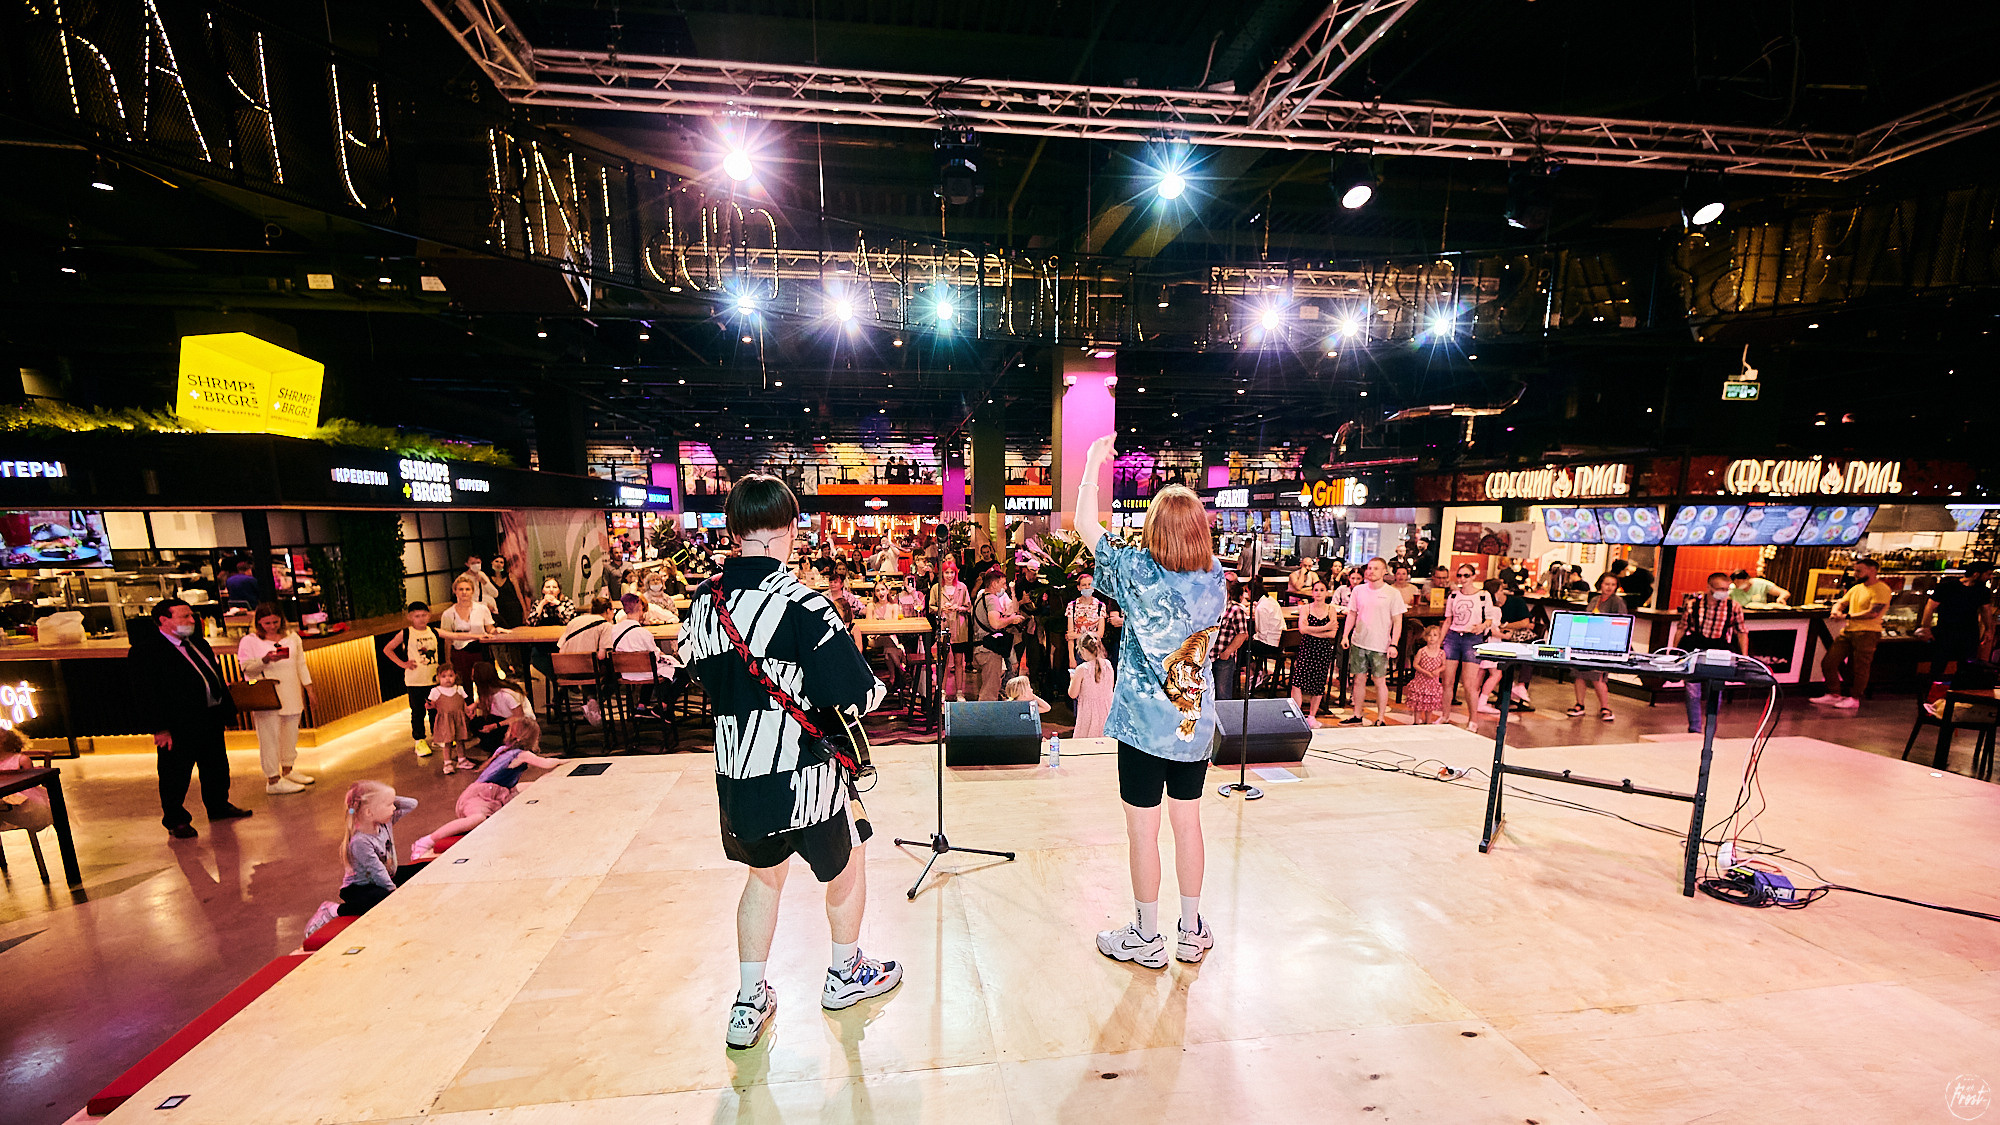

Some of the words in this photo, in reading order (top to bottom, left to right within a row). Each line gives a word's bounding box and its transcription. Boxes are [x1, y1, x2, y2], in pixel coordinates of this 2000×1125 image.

[0, 461, 65, 478] ГЕРЫ
[334, 467, 389, 486] КРЕВЕТКИ
[1843, 460, 1903, 494] ГРИЛЬ
[1573, 463, 1629, 496] ГРИЛЬ
[1004, 497, 1053, 511] ARTINI
